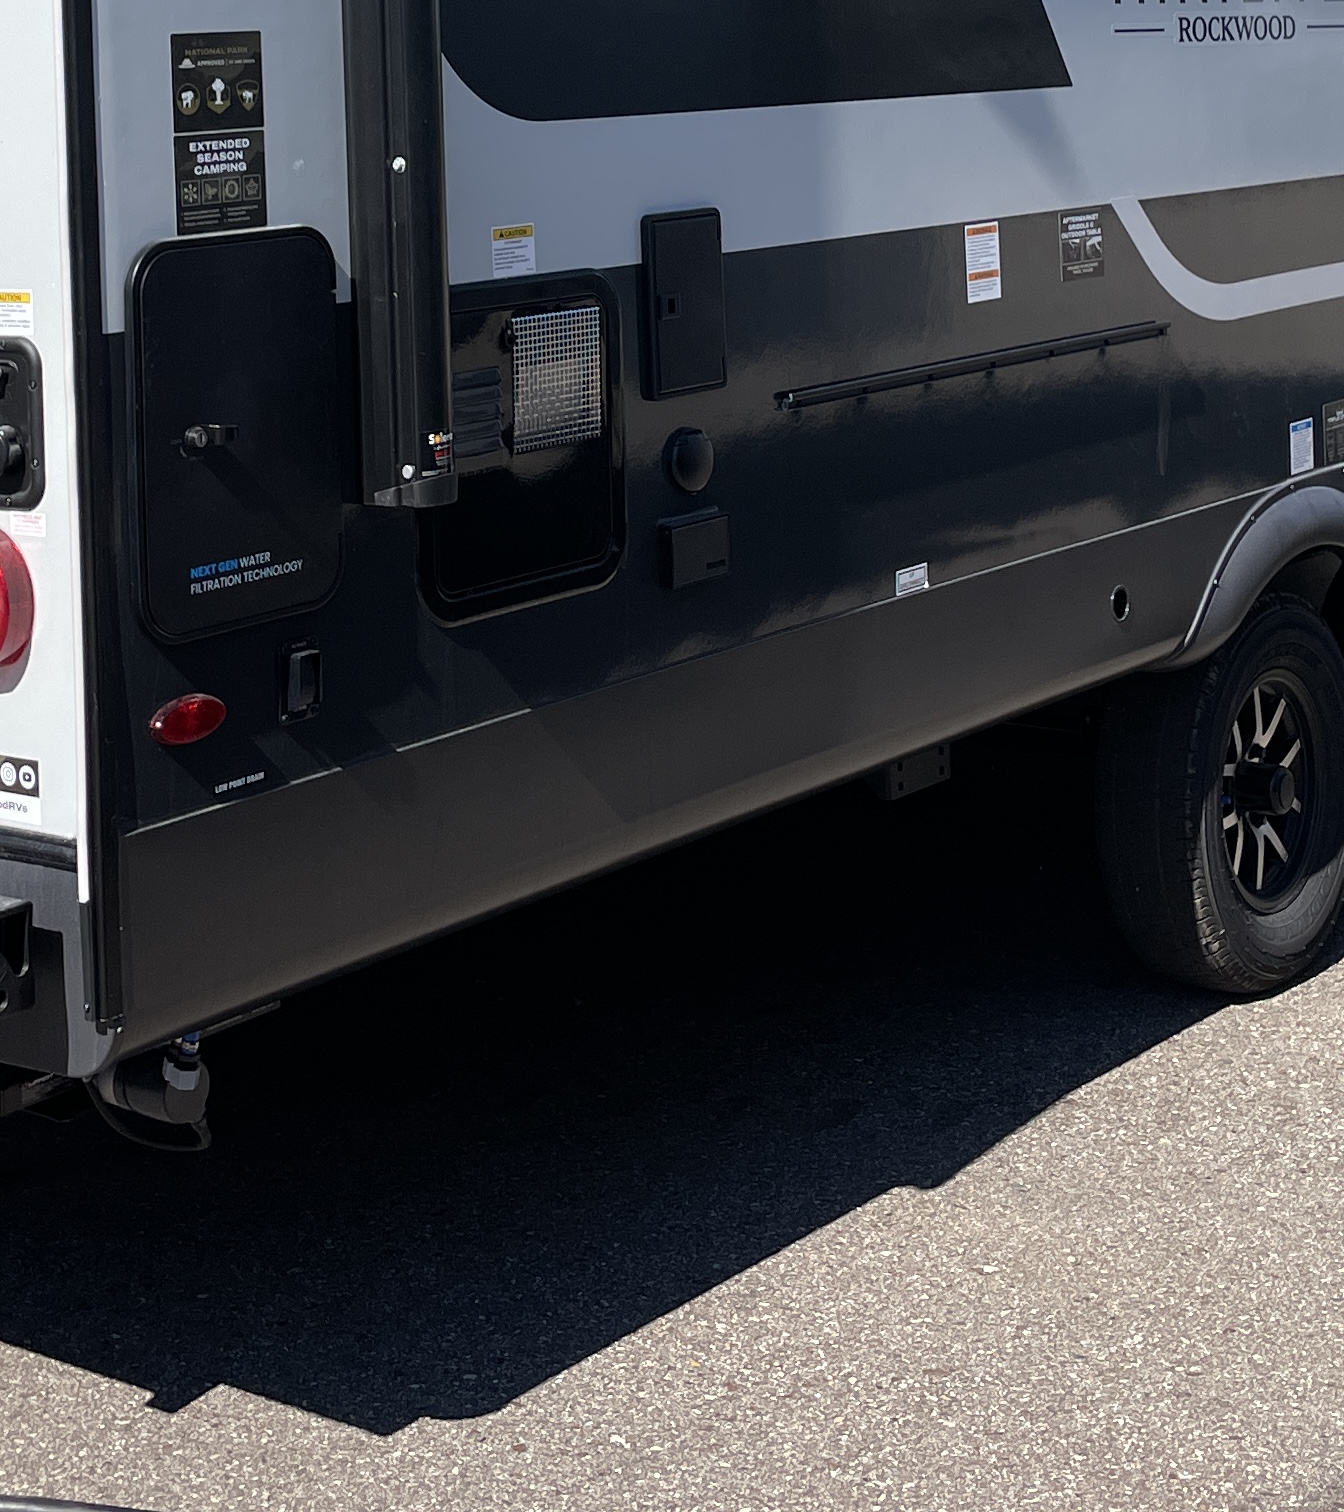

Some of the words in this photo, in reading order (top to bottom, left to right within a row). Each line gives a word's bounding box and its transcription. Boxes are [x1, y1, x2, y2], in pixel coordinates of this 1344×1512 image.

[1178, 15, 1296, 43] ROCKWOOD
[184, 48, 225, 56] NATIONAL
[227, 46, 248, 55] PARK
[189, 138, 250, 152] EXTENDED
[197, 150, 244, 164] SEASON
[194, 161, 247, 176] CAMPING
[190, 563, 217, 579] NEXT
[218, 559, 239, 573] GEN
[239, 551, 271, 568] WATER
[190, 573, 242, 596] FILTRATION
[243, 559, 304, 583] TECHNOLOGY
